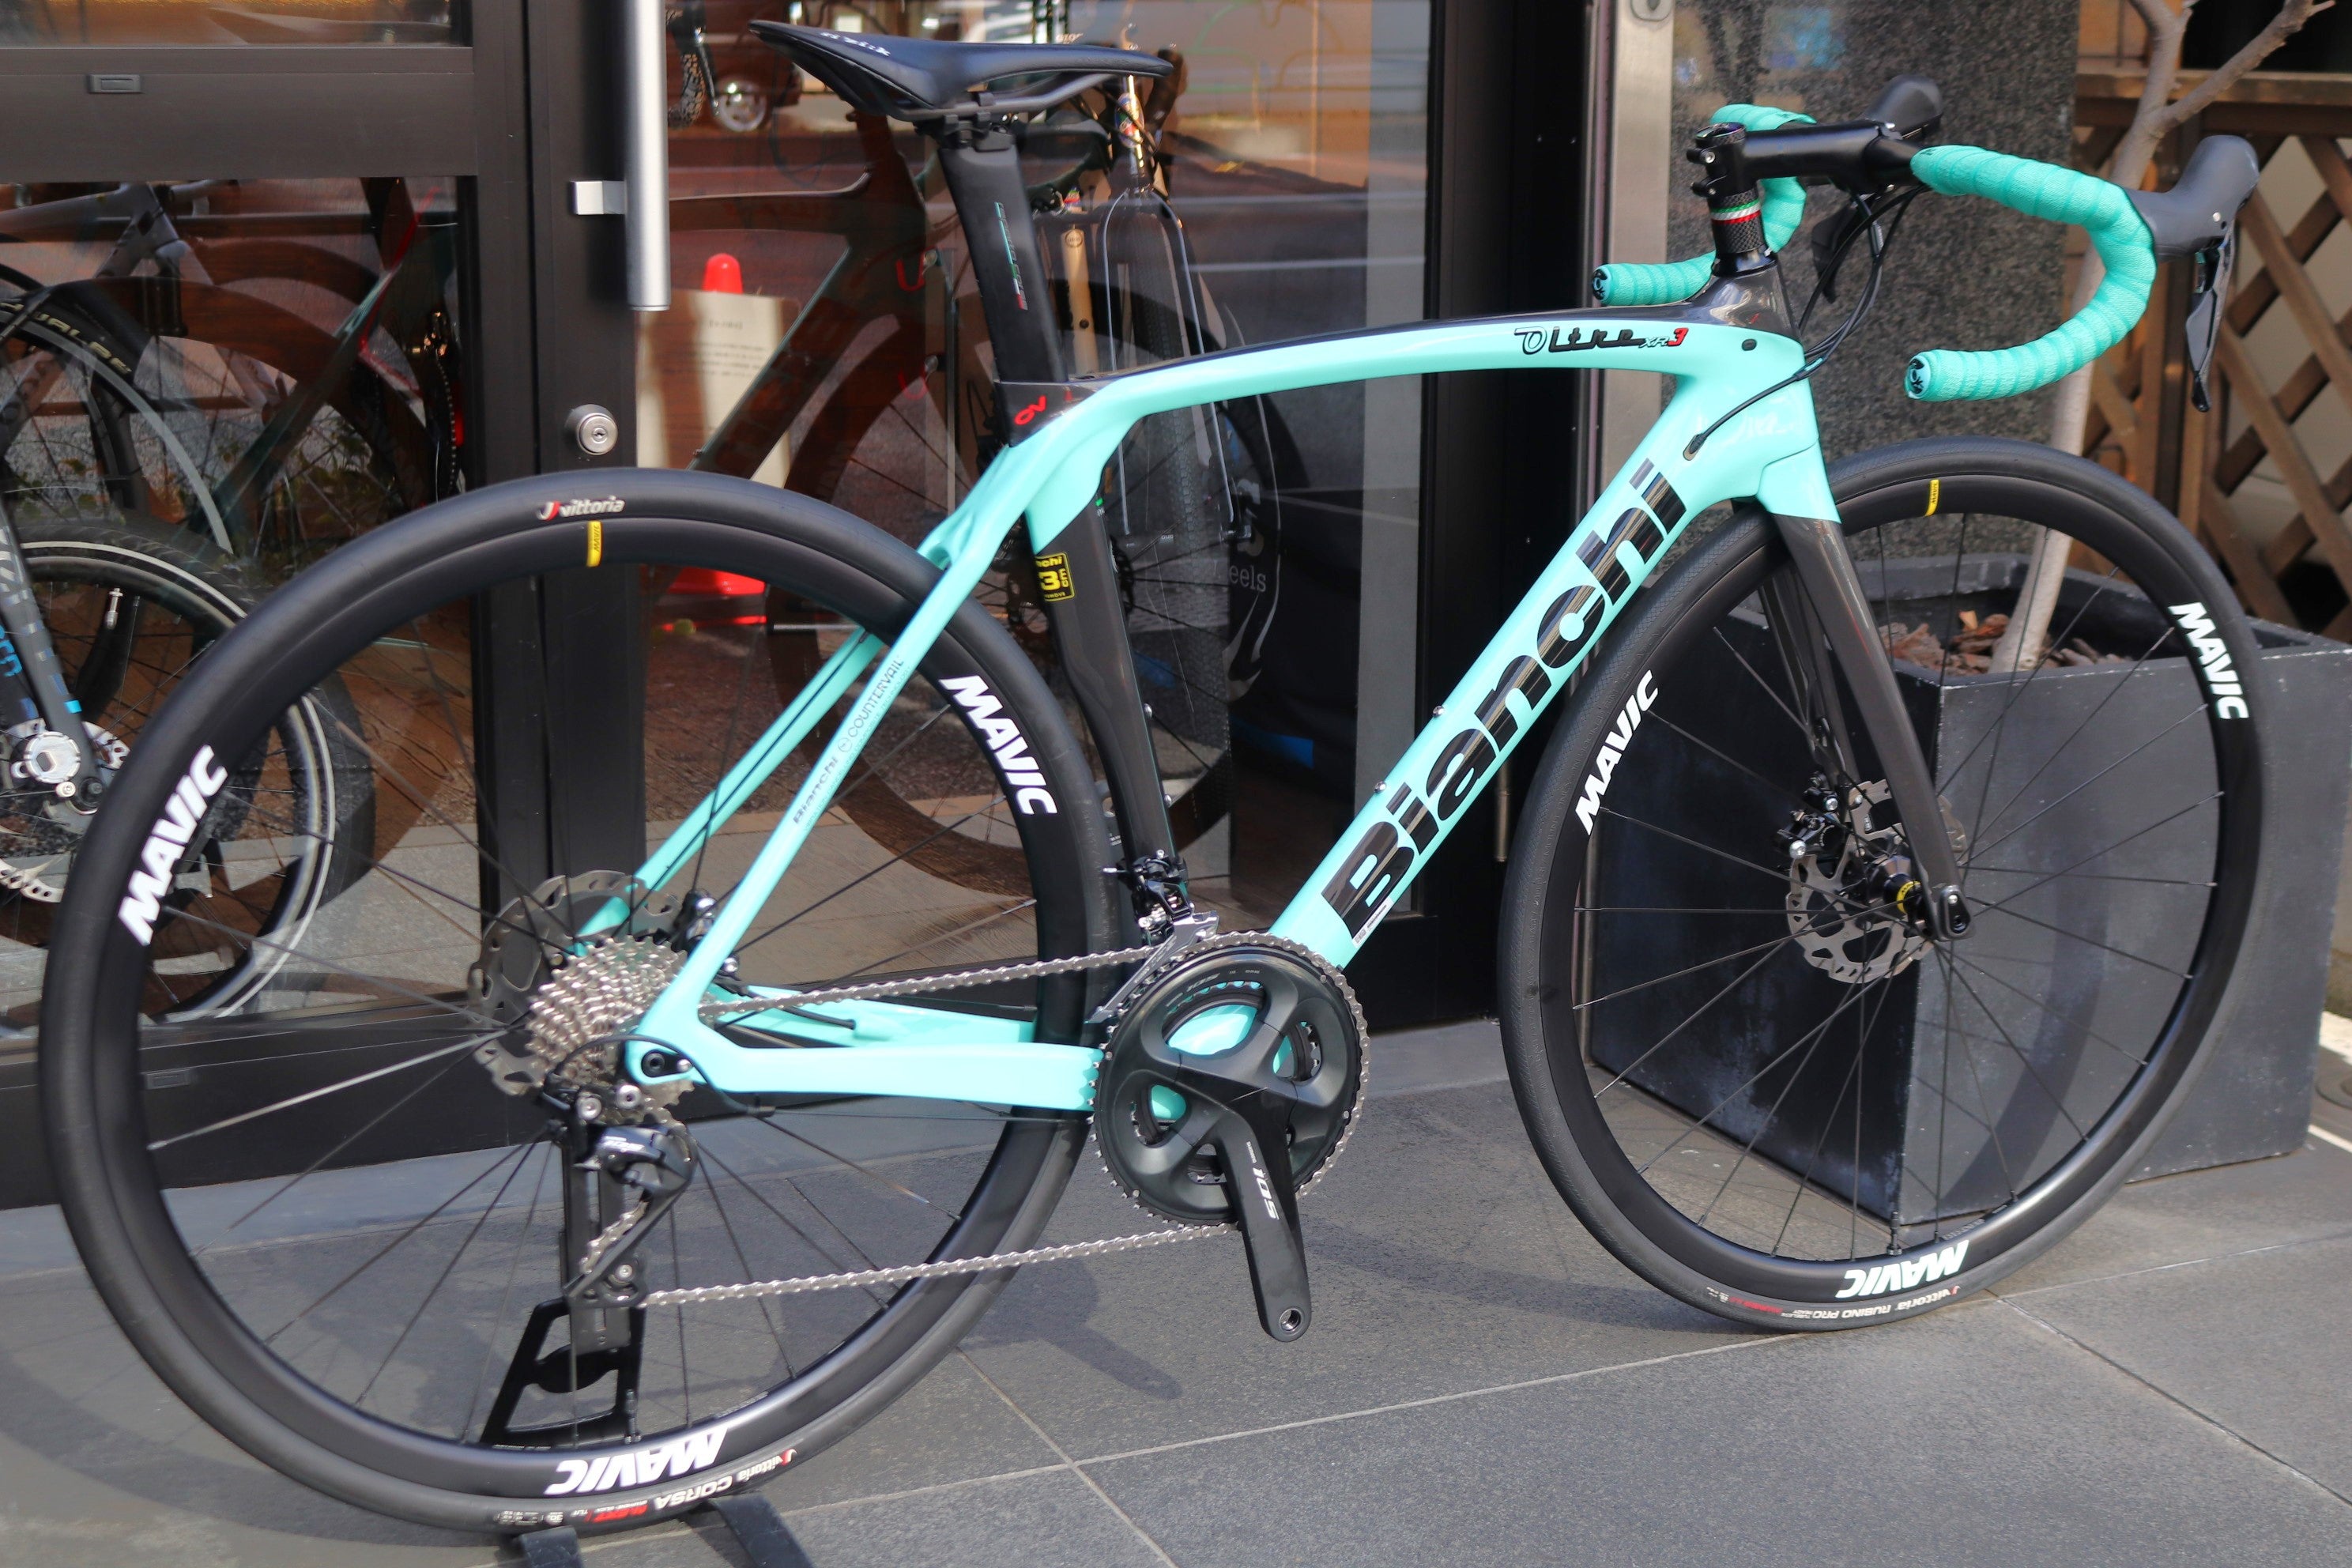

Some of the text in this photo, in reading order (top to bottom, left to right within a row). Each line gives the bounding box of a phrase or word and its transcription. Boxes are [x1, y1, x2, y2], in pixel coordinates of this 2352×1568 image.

[1513, 326, 1646, 356] Oltre
[559, 495, 626, 518] vittoria
[2169, 602, 2248, 720] MAVIC
[1321, 458, 1687, 938] Bianchi
[939, 675, 1057, 815] MAVIC
[1575, 669, 1658, 836] MAVIC
[793, 756, 839, 824] Bianchi
[118, 744, 228, 945] MAVIC
[1252, 1167, 1280, 1220] 105
[1835, 1239, 1969, 1298] MAVIC
[1812, 1288, 1951, 1319] vittoria RUBINO PRO
[543, 1425, 729, 1496] MAVIC
[736, 1455, 784, 1483] vittoria
[654, 1475, 733, 1510] CORSA
